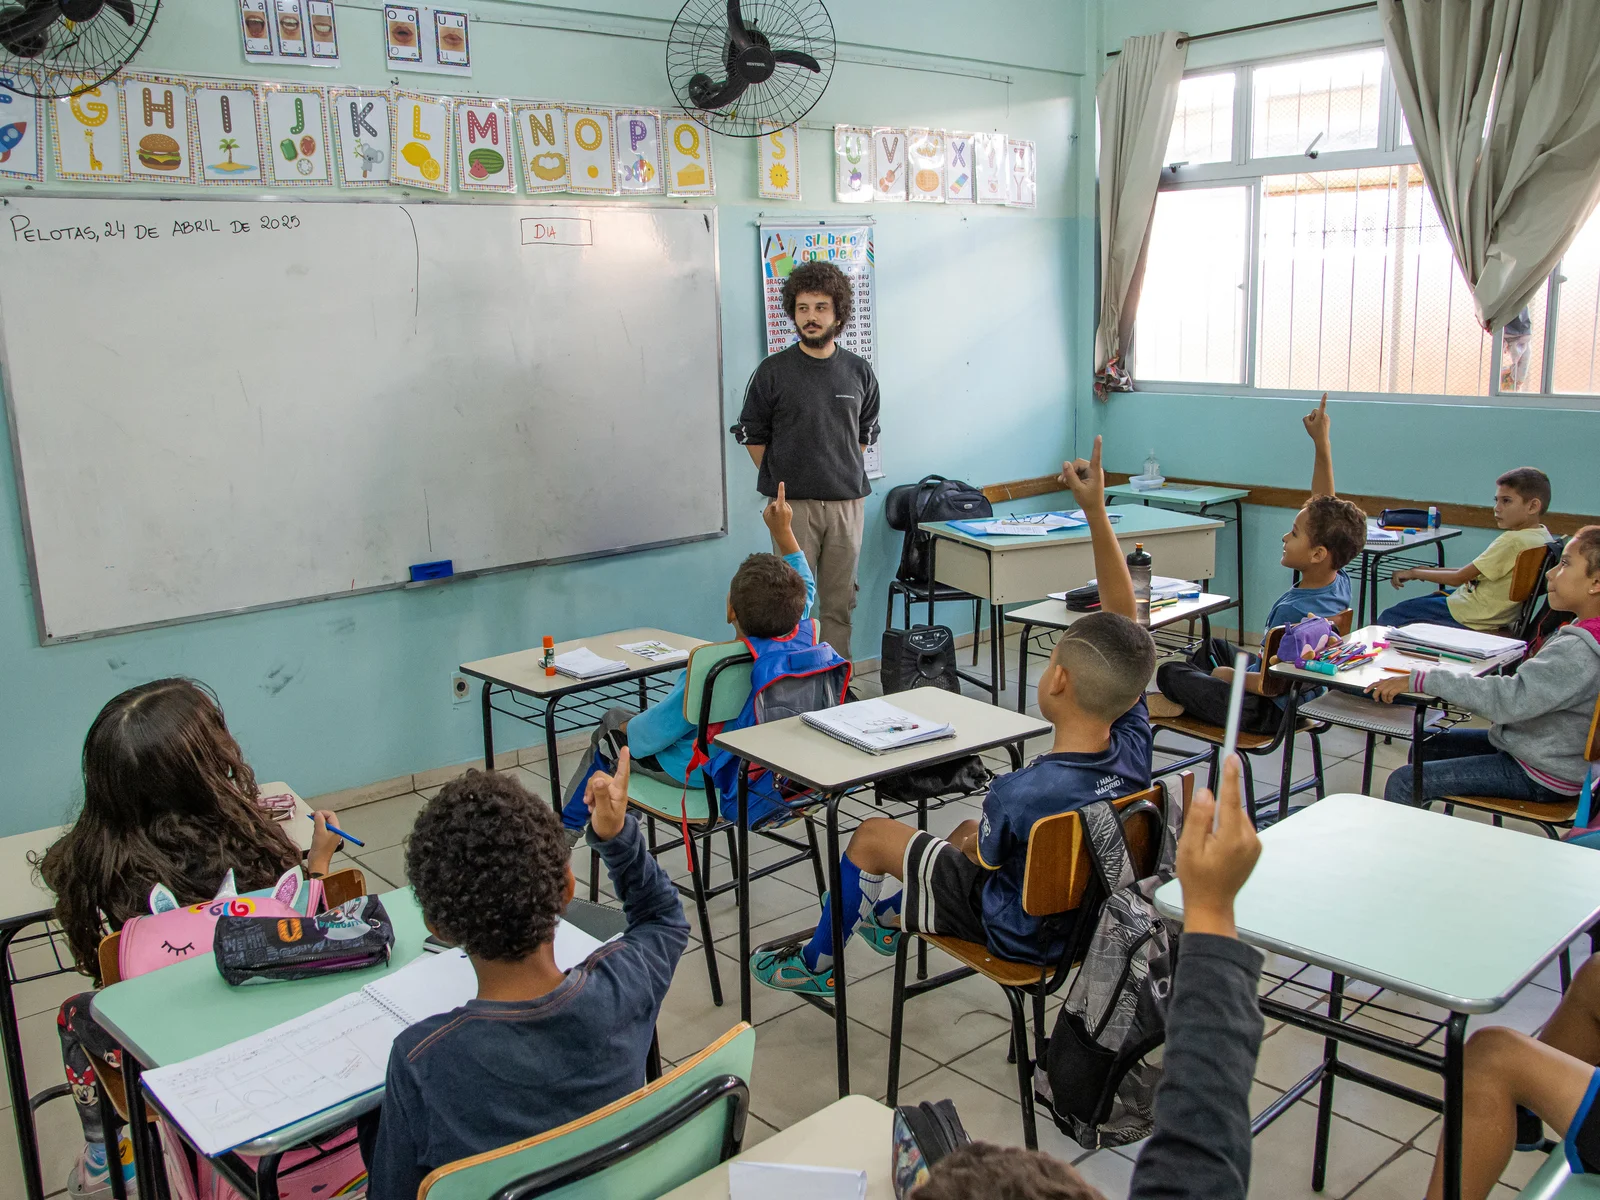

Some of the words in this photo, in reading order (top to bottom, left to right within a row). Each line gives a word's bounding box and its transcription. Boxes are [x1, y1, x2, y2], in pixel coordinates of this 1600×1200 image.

[277, 2, 284, 11] E
[388, 10, 397, 19] O
[438, 16, 446, 25] U
[69, 84, 108, 127] G
[142, 87, 173, 129] H
[220, 95, 232, 133] I
[290, 97, 305, 135] J
[350, 101, 378, 137] K
[413, 105, 431, 140] L
[467, 110, 498, 145] M
[529, 113, 555, 146] N
[574, 118, 602, 151] O
[630, 120, 646, 151] P
[674, 123, 700, 160] Q
[770, 131, 786, 160] S
[845, 135, 863, 164] U
[882, 136, 899, 163] V
[952, 141, 966, 167] X
[104, 220, 125, 239] 24
[134, 225, 159, 239] DE
[172, 219, 220, 236] ABRIL
[230, 220, 250, 233] DE
[260, 215, 301, 230] 2025
[769, 328, 791, 336] TRATOR
[319, 920, 364, 930] ALIFORNIA
